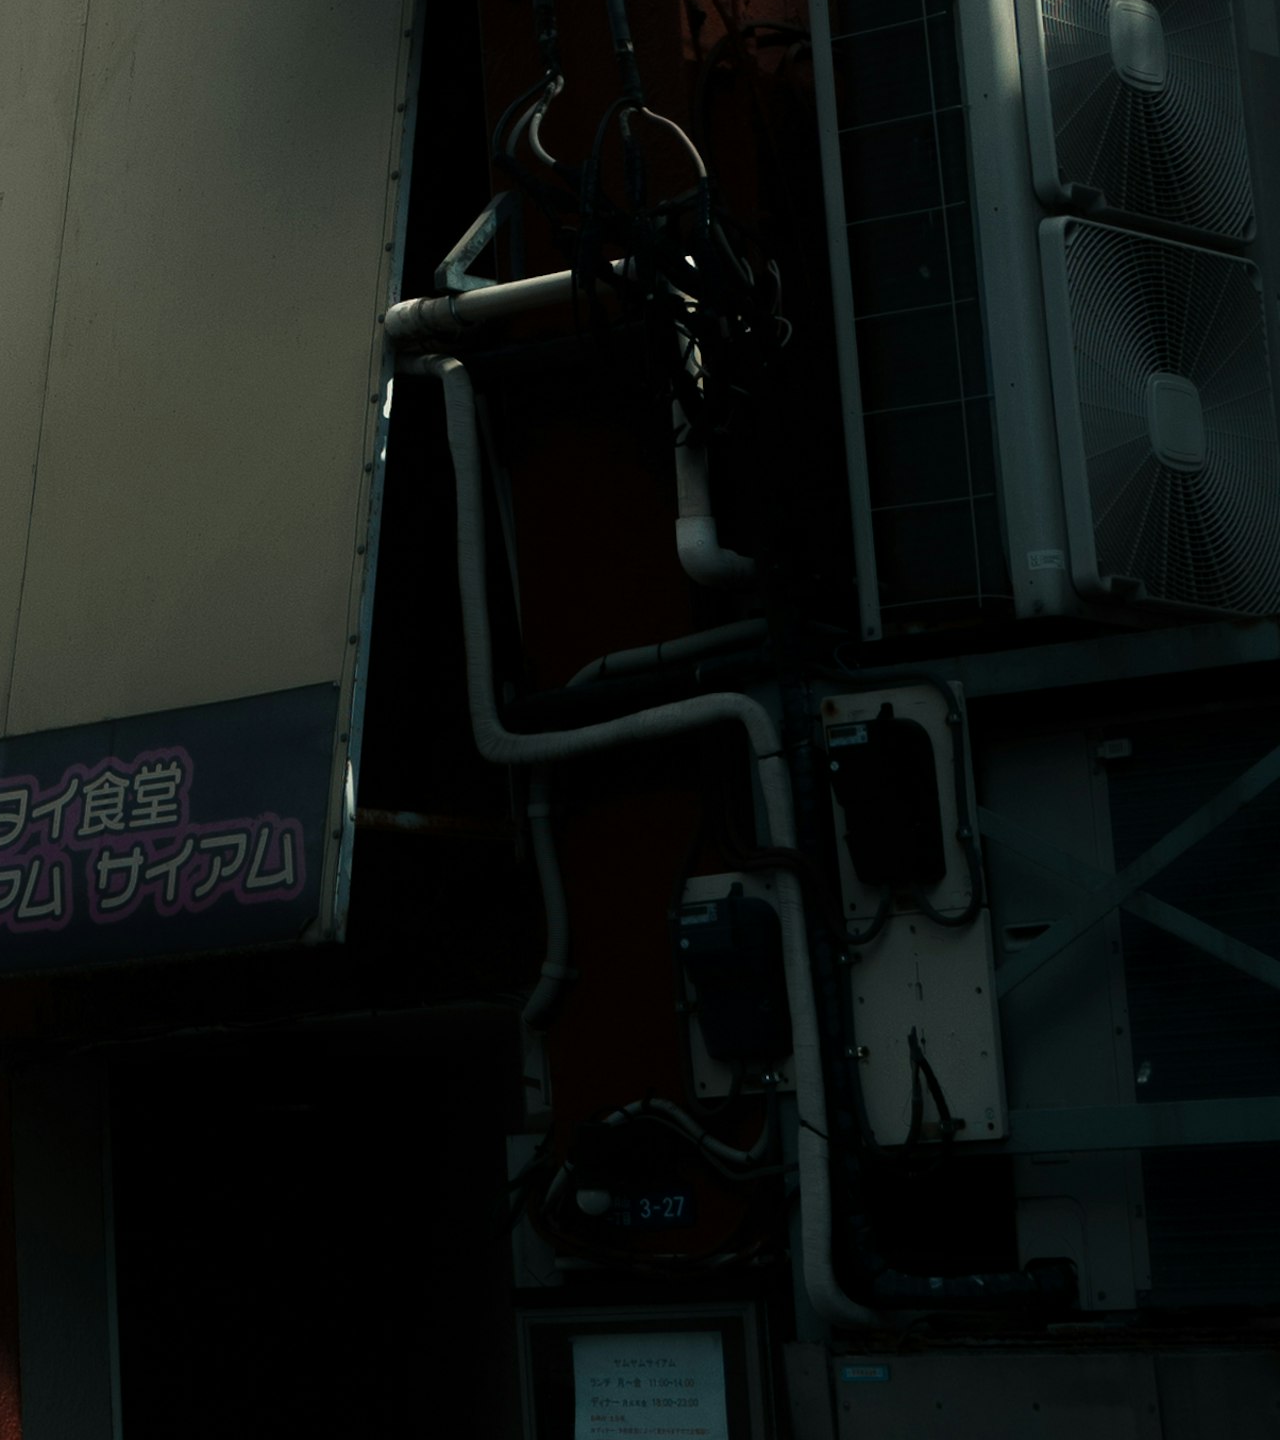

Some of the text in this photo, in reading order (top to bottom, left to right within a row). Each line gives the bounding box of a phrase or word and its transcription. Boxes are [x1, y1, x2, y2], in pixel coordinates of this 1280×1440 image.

[96, 827, 295, 908] サイアム
[639, 1196, 685, 1219] 3-27
